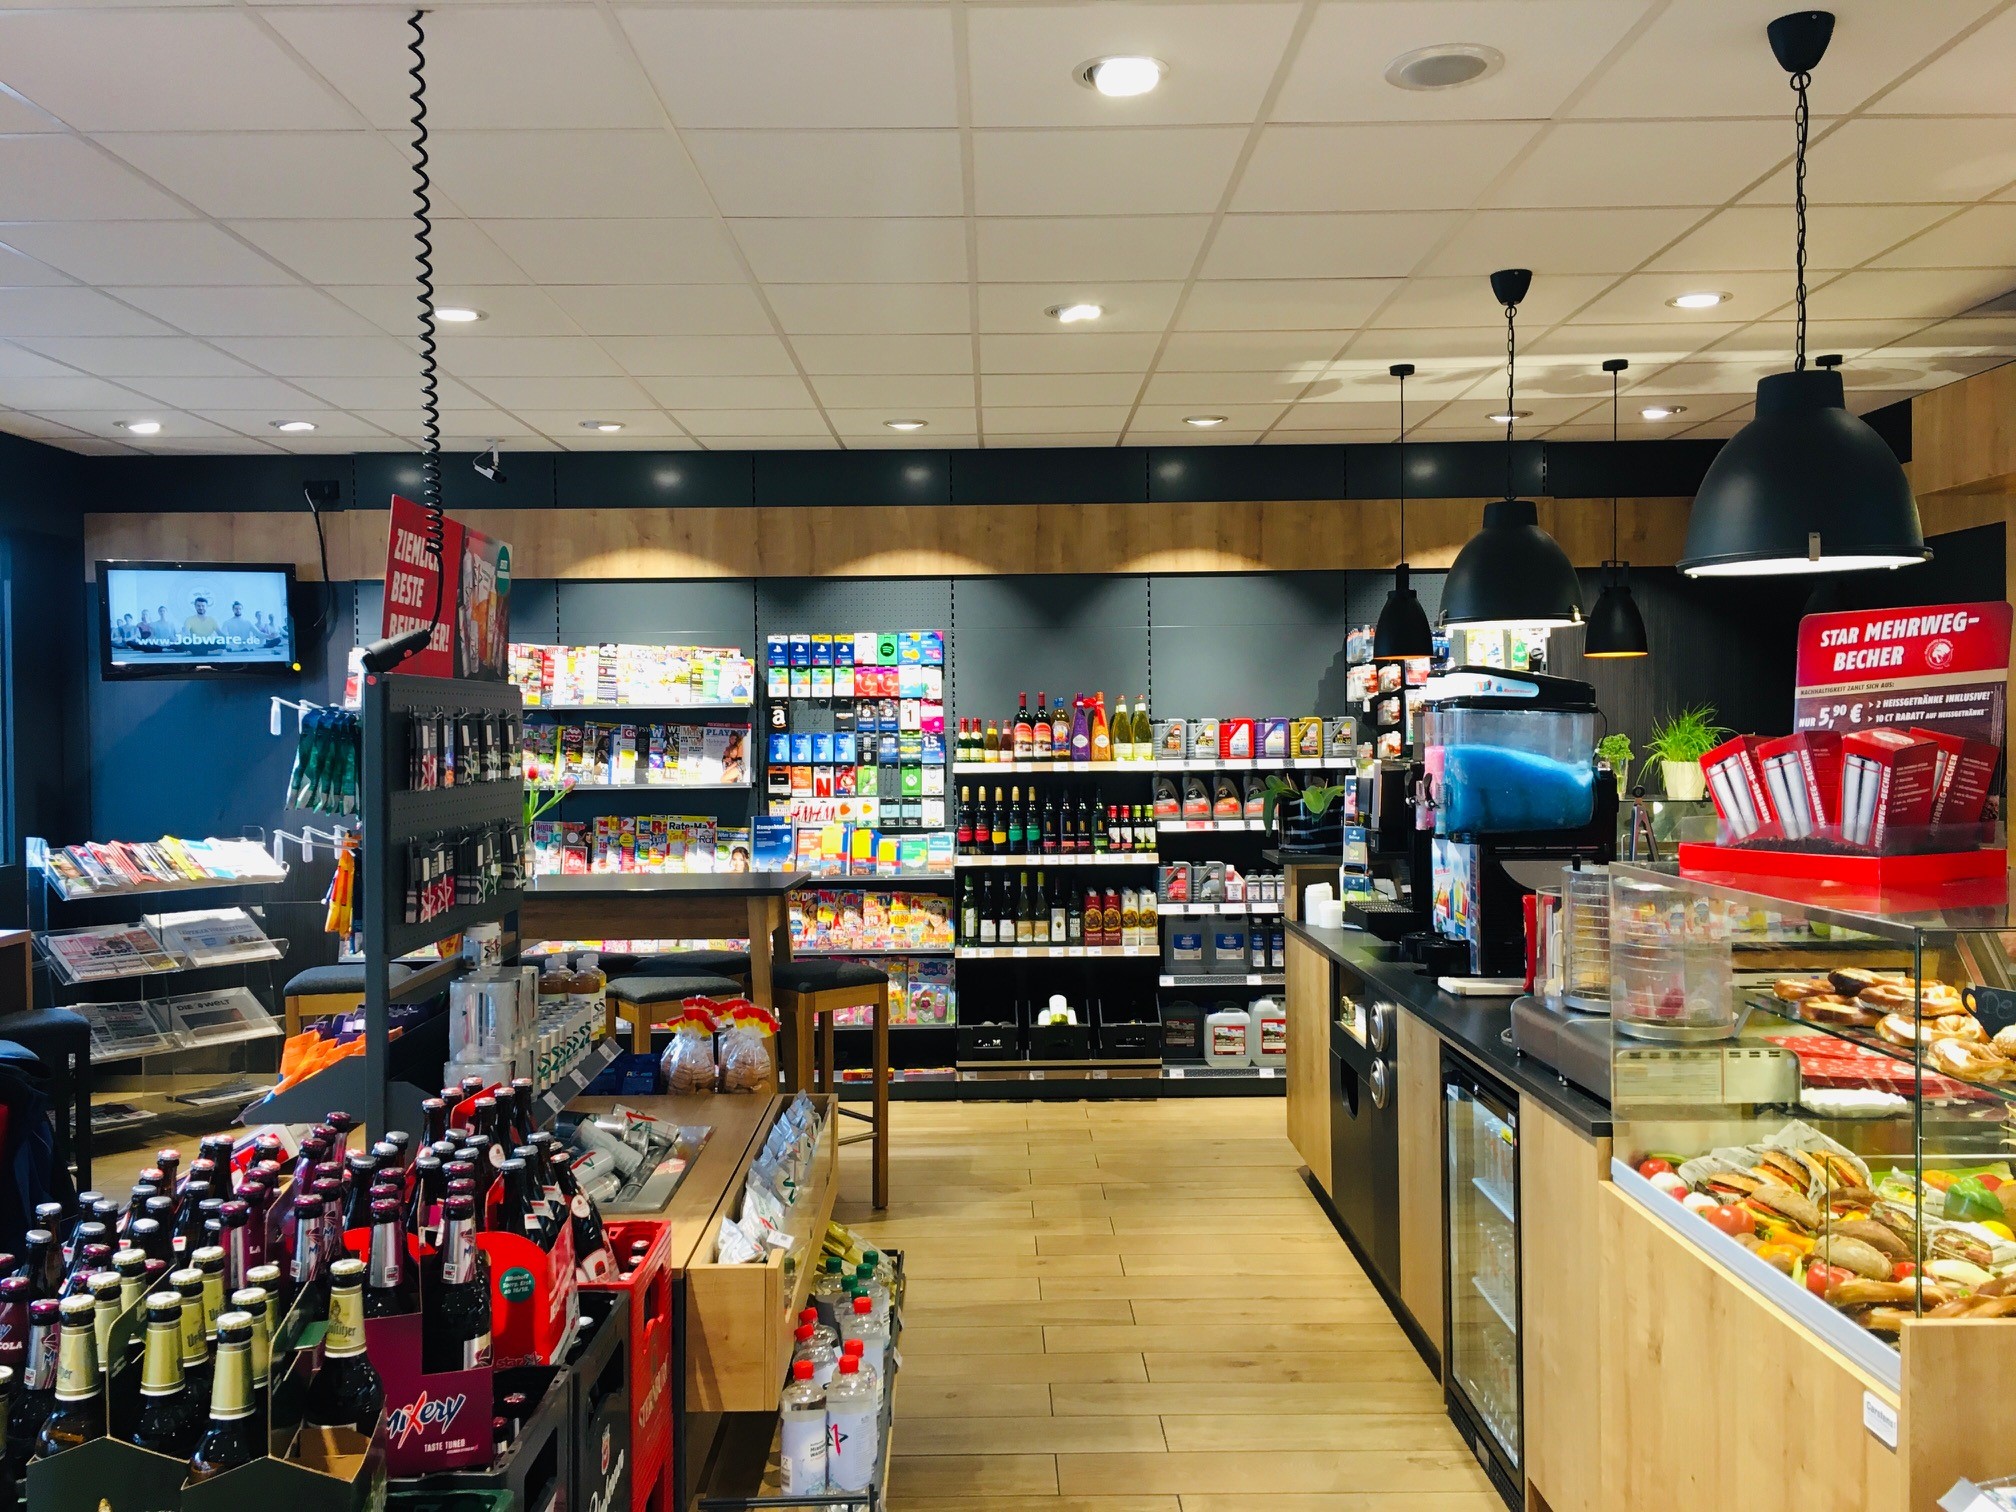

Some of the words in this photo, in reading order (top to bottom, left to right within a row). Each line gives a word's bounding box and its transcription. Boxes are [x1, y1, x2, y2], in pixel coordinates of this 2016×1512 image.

[390, 572, 424, 608] BESTE
[137, 633, 261, 646] www.Jobware.de
[1820, 628, 1860, 648] STAR
[1864, 611, 1980, 643] MEHRWEG-
[1833, 646, 1905, 672] BECHER
[1798, 717, 1816, 728] NUR
[1850, 703, 1864, 723] €
[1876, 714, 1884, 722] 10
[1895, 711, 1926, 722] RABATT
[1926, 712, 1937, 720] AUF
[1874, 766, 1892, 848] MEHRWEG-BECHER
[424, 1442, 442, 1453] TASTE
[445, 1438, 466, 1450] TUNED
